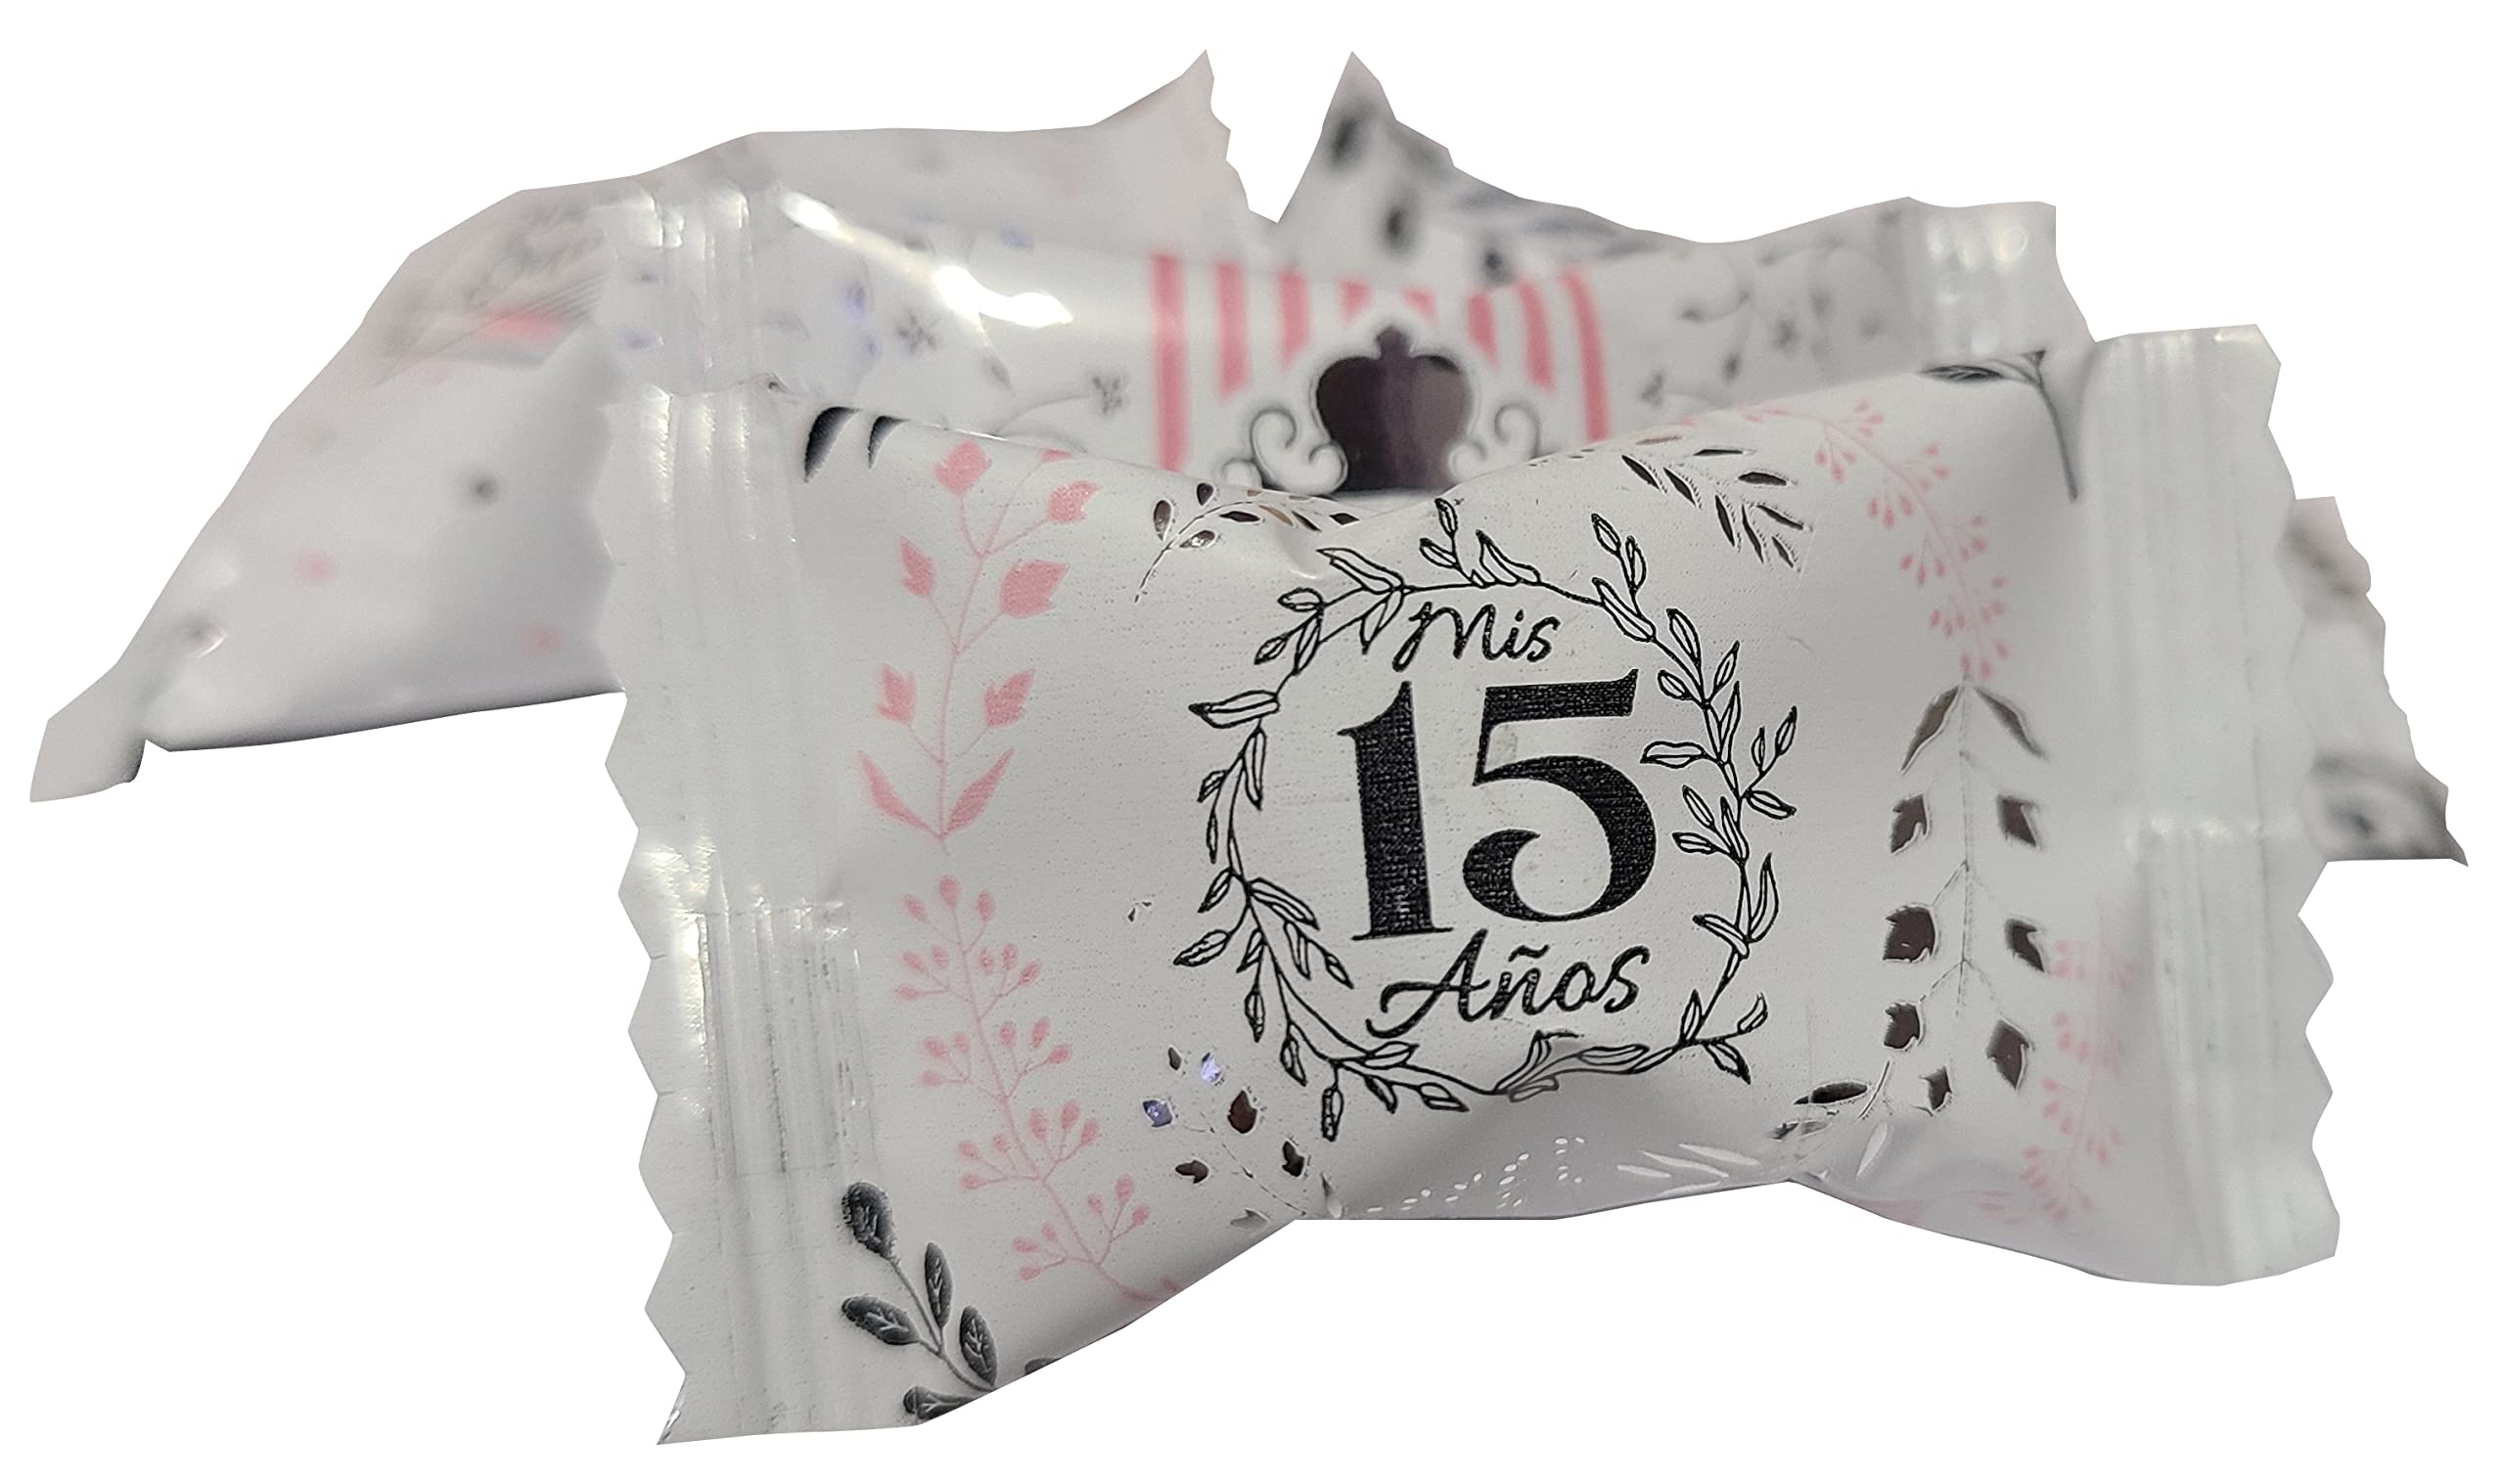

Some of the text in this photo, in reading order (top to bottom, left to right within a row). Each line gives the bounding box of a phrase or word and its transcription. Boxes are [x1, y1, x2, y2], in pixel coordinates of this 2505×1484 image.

[1391, 603, 1561, 671] Mis
[1337, 668, 1657, 940] 15
[1366, 928, 1650, 1039] Años
